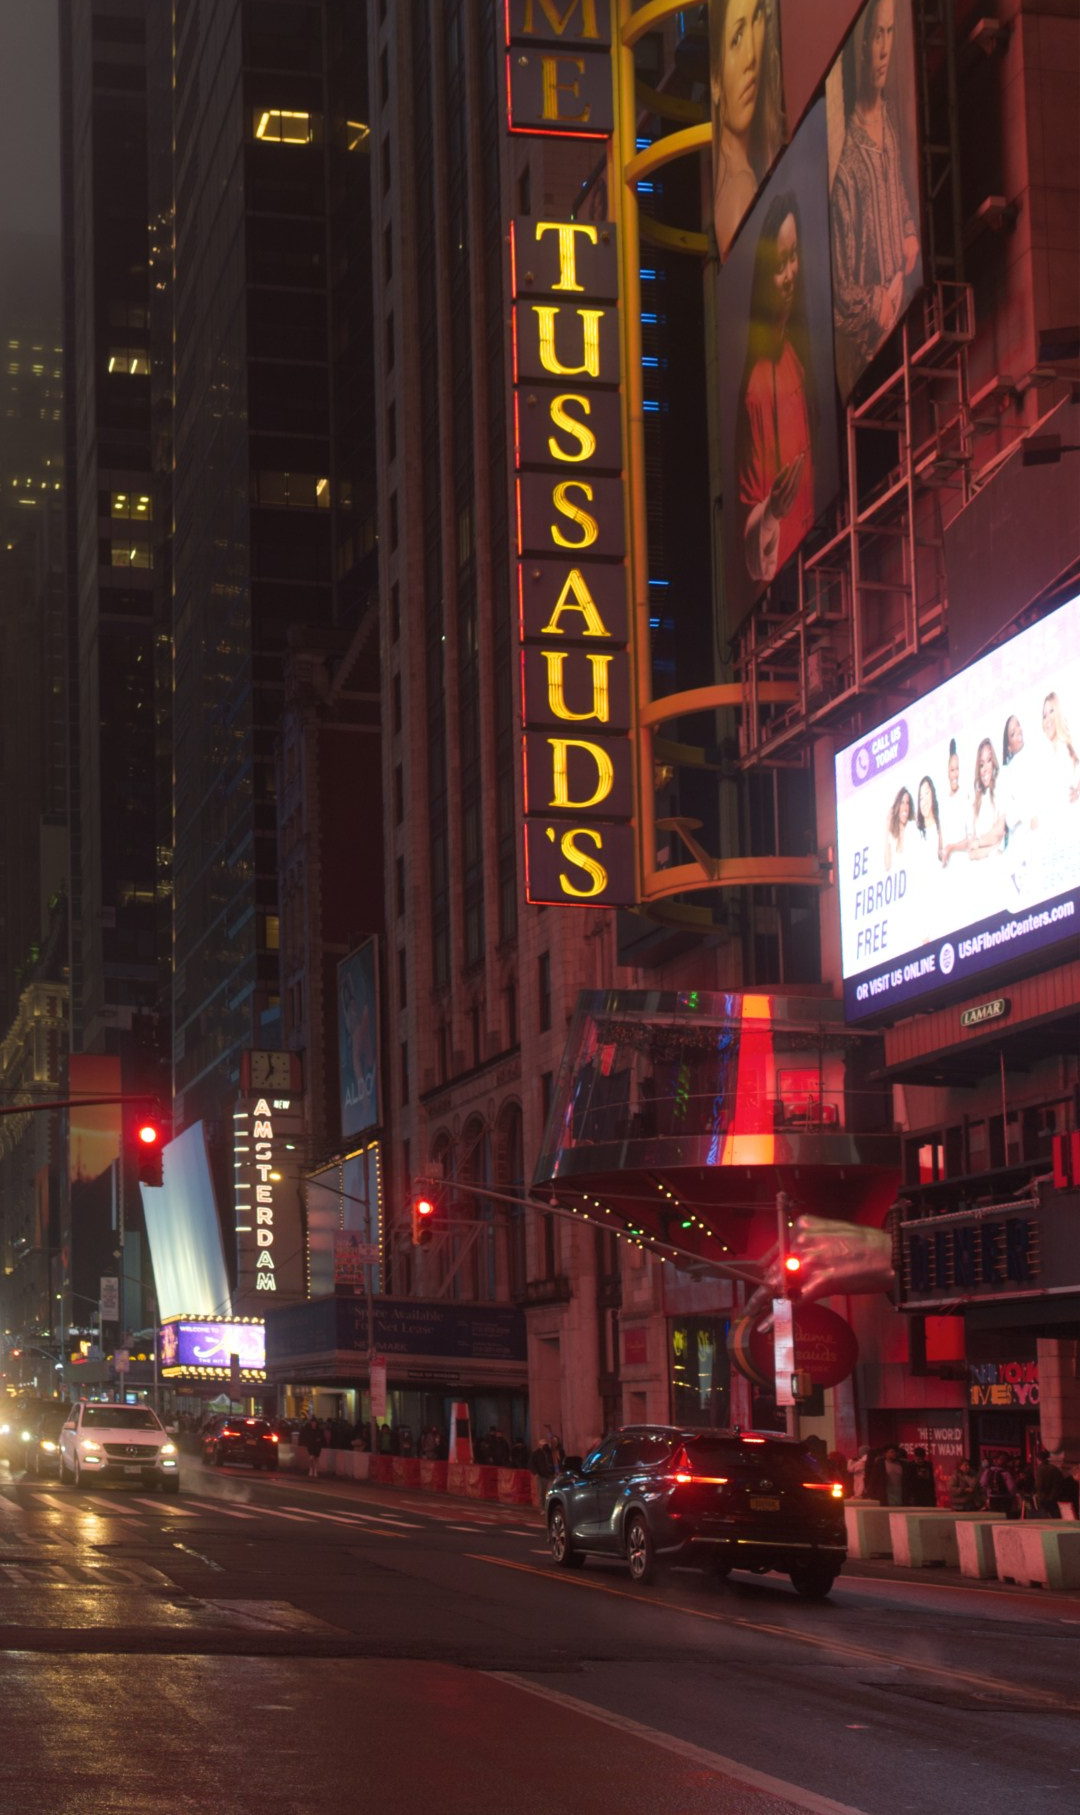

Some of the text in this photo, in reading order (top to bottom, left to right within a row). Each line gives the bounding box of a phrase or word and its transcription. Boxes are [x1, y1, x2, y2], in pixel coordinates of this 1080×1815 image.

[531, 221, 613, 898] TUSSAUD'S
[872, 725, 902, 754] CALL US
[875, 743, 899, 769] TODAY
[853, 846, 869, 881] BE
[855, 869, 907, 921] FIBROID
[856, 920, 888, 960] FREE
[856, 900, 1075, 1001] OR VISIT US ONLINE USAFibroidCenters.com
[963, 1001, 1002, 1024] LAMAR
[274, 1099, 290, 1110] NEW
[344, 1073, 373, 1109] ALDO
[253, 1098, 277, 1291] AMSTERDAM
[353, 1306, 444, 1323] Spce Available
[378, 1320, 399, 1332] Net
[401, 1320, 435, 1334] Lease
